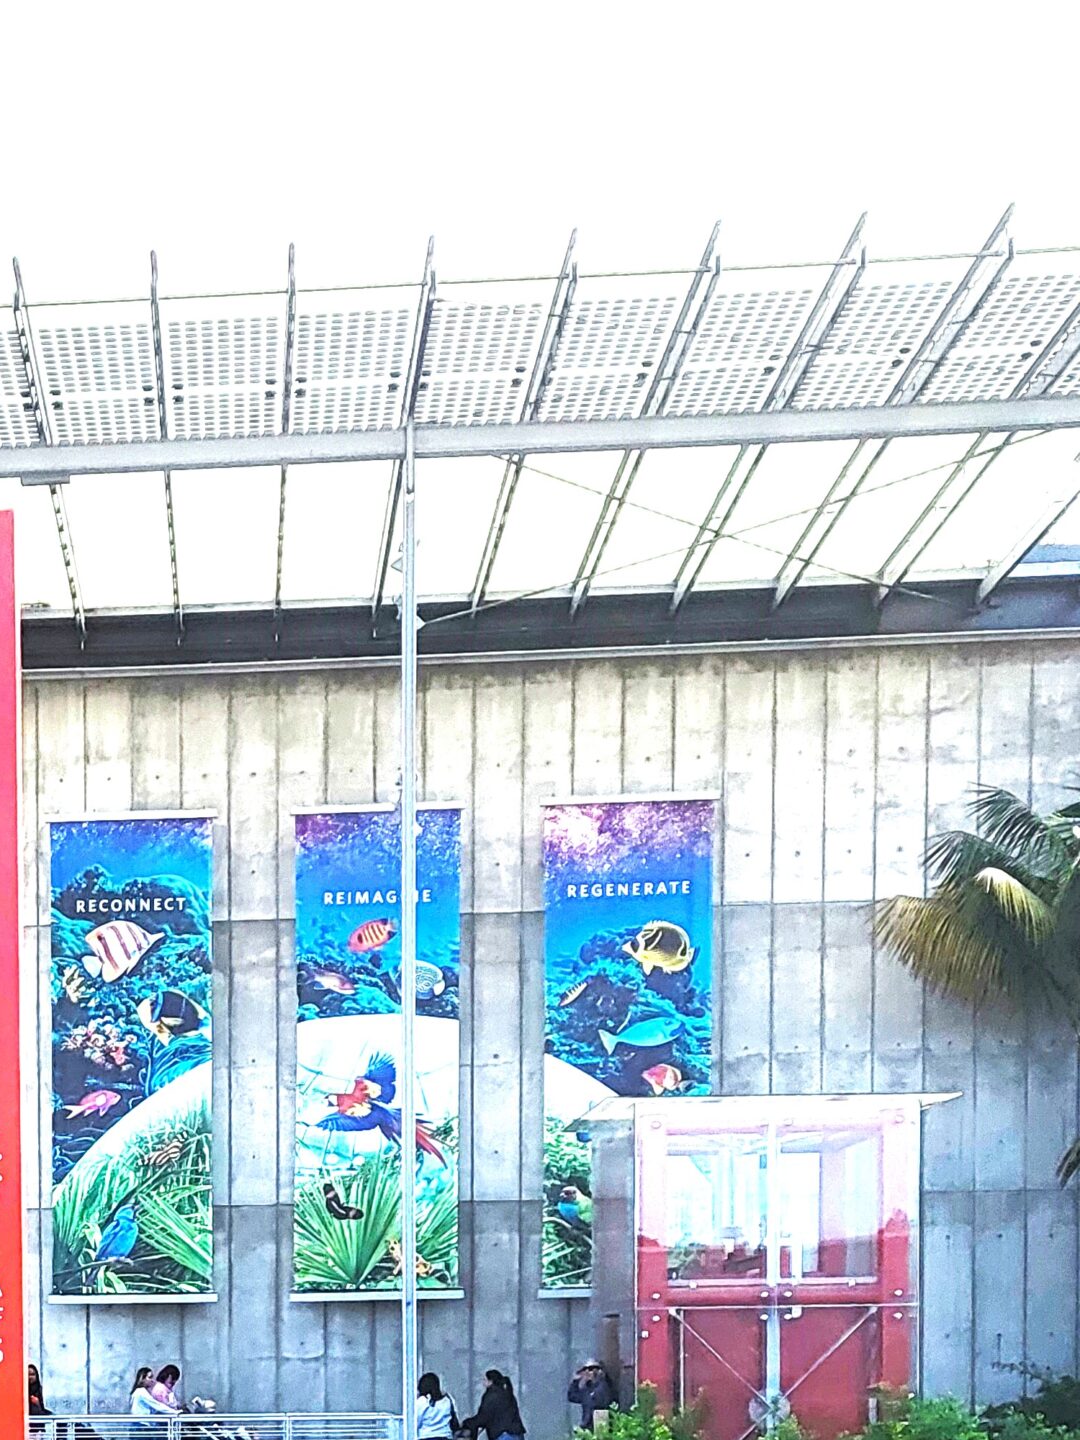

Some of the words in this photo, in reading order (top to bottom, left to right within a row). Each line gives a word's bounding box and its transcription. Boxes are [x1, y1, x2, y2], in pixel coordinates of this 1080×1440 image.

[323, 889, 432, 905] REIMAGE
[566, 880, 691, 898] REGENERATE
[75, 897, 187, 913] RECONNECT
